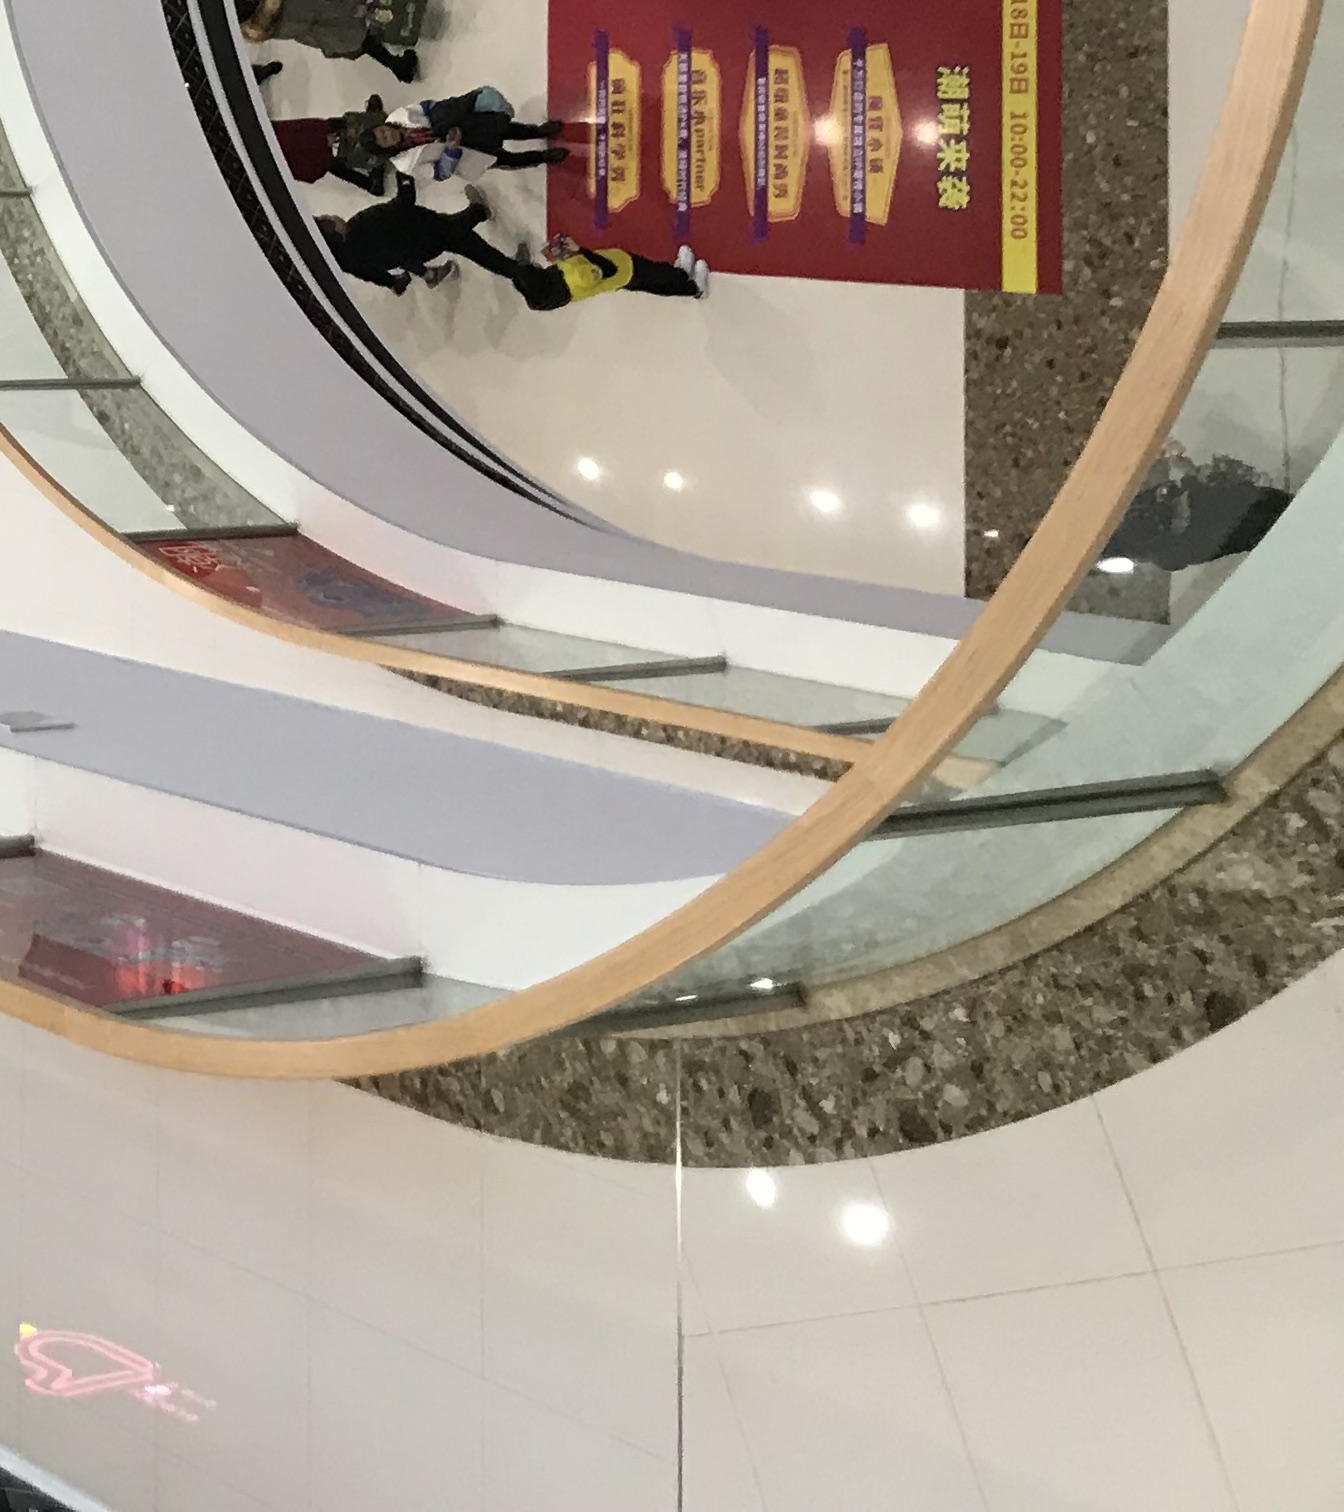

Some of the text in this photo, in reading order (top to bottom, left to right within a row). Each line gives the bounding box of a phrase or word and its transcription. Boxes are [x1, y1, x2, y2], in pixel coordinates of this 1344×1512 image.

[934, 64, 971, 211] 潮萌来袭
[1007, 110, 1028, 240] 10:00-22:00
